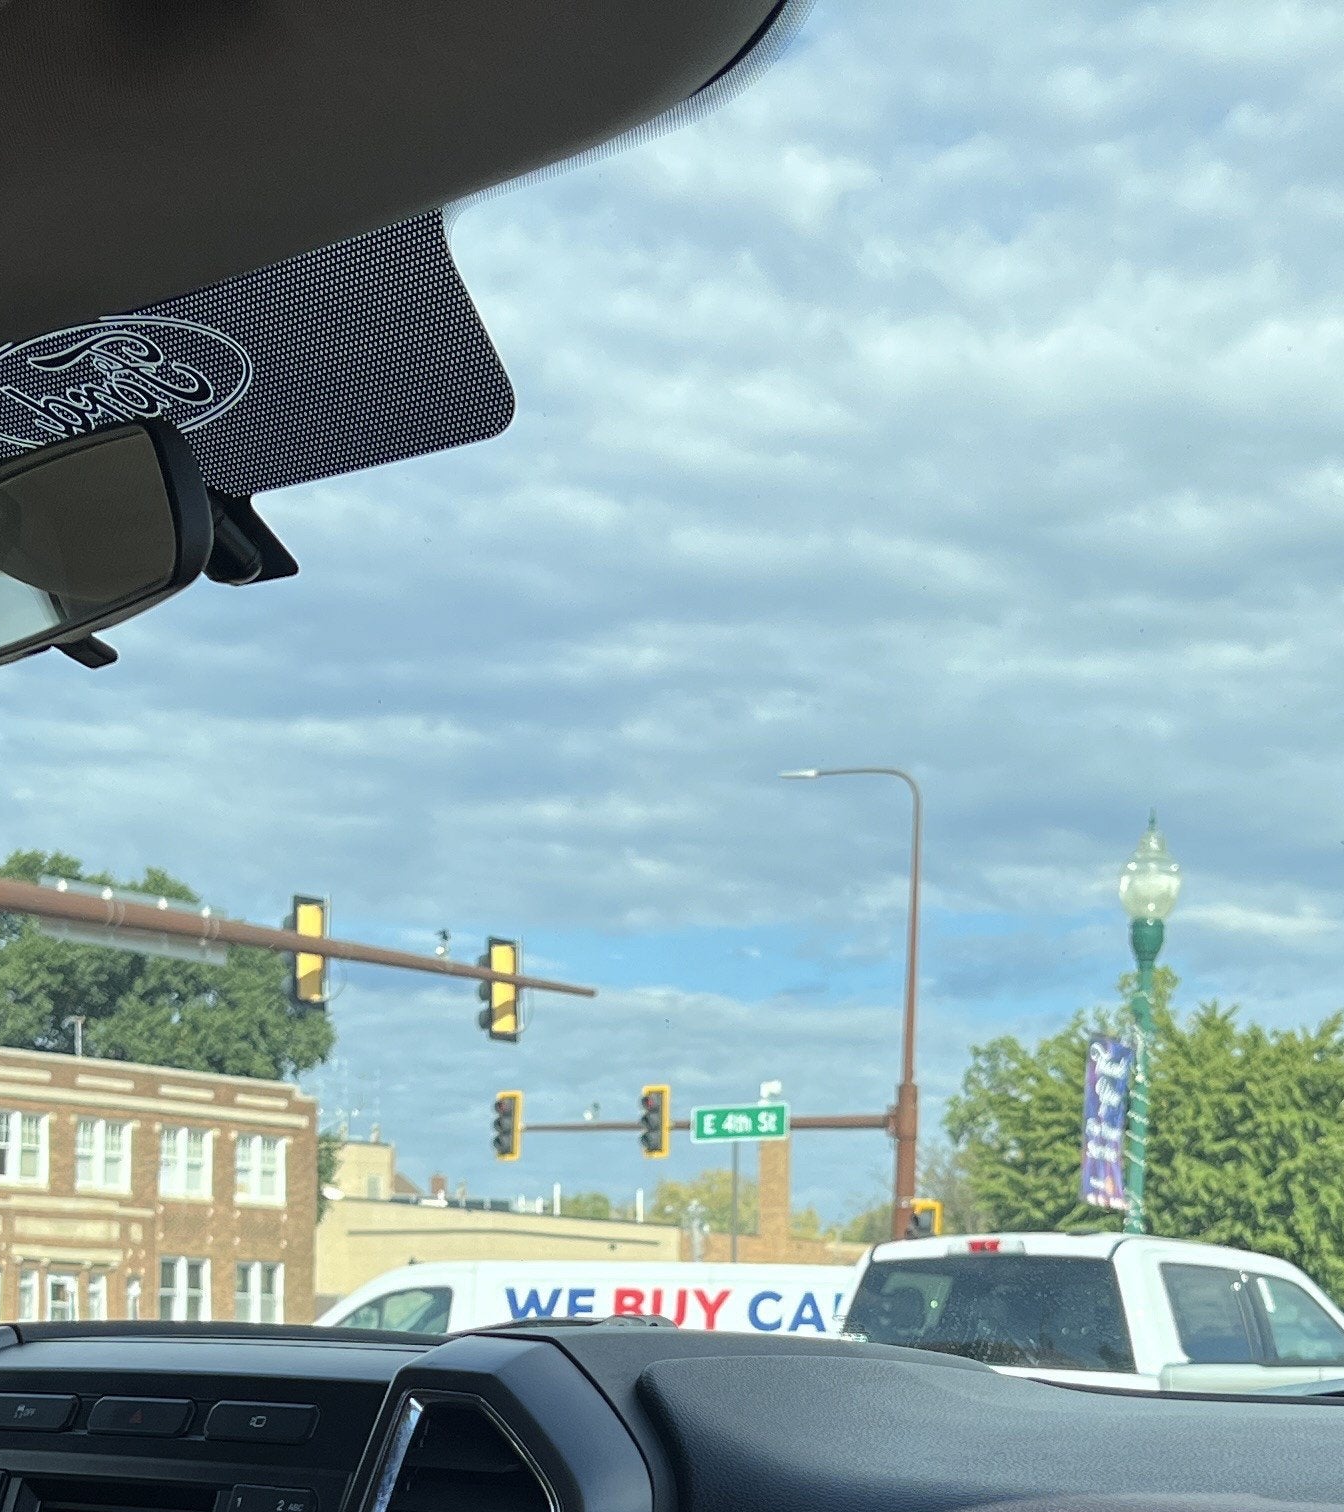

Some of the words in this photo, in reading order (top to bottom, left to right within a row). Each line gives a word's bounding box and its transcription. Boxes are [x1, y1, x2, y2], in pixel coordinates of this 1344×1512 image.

[703, 1113, 717, 1135] E
[721, 1112, 753, 1134] 4th
[757, 1110, 777, 1133] St
[505, 1287, 596, 1319] WE
[613, 1287, 732, 1332] BUY
[235, 1496, 243, 1508] 1
[276, 1500, 285, 1512] 2
[287, 1502, 305, 1512] ABC
